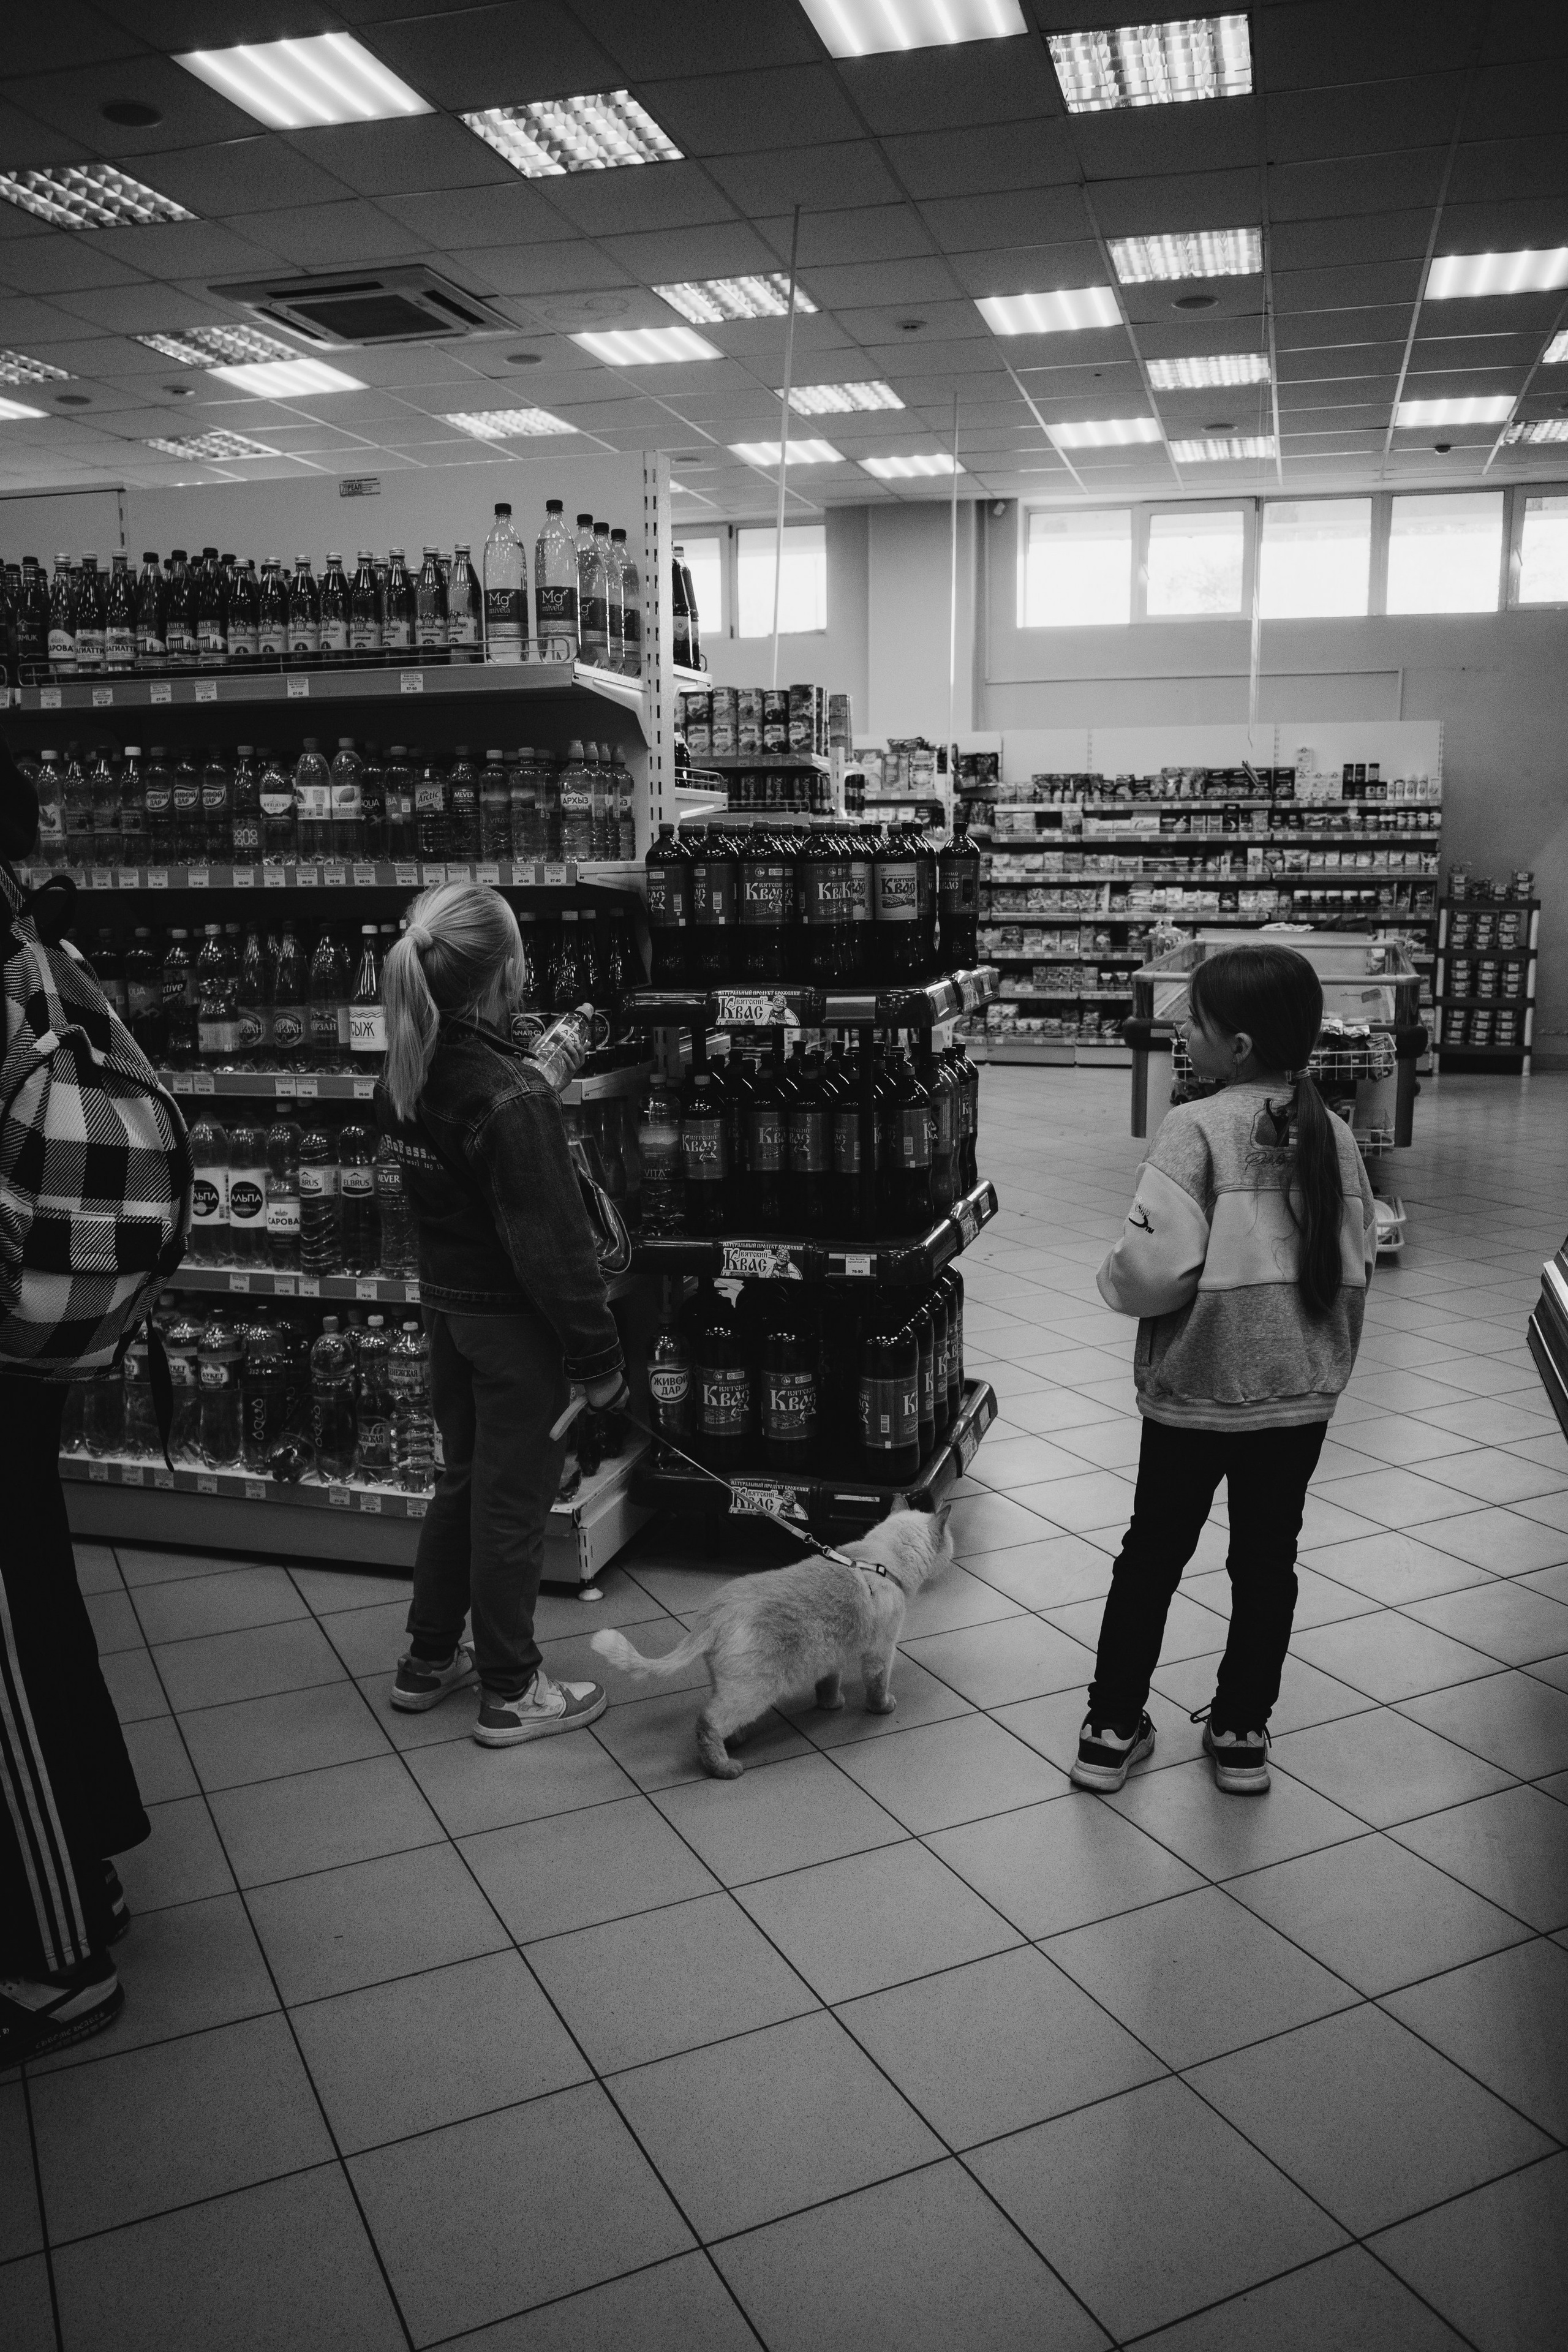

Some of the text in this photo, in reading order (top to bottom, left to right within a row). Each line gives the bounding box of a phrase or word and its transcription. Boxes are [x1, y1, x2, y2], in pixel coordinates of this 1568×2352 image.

[162, 982, 184, 993] ctive
[241, 1024, 263, 1033] РЗАН
[276, 1023, 304, 1033] АРЗАН
[561, 1029, 578, 1042] АРХ
[194, 1192, 219, 1201] ЛЬПА
[231, 1193, 262, 1203] АЛЬПА
[654, 1374, 688, 1387] ЖИВОЙ
[662, 1385, 681, 1396] ДАР
